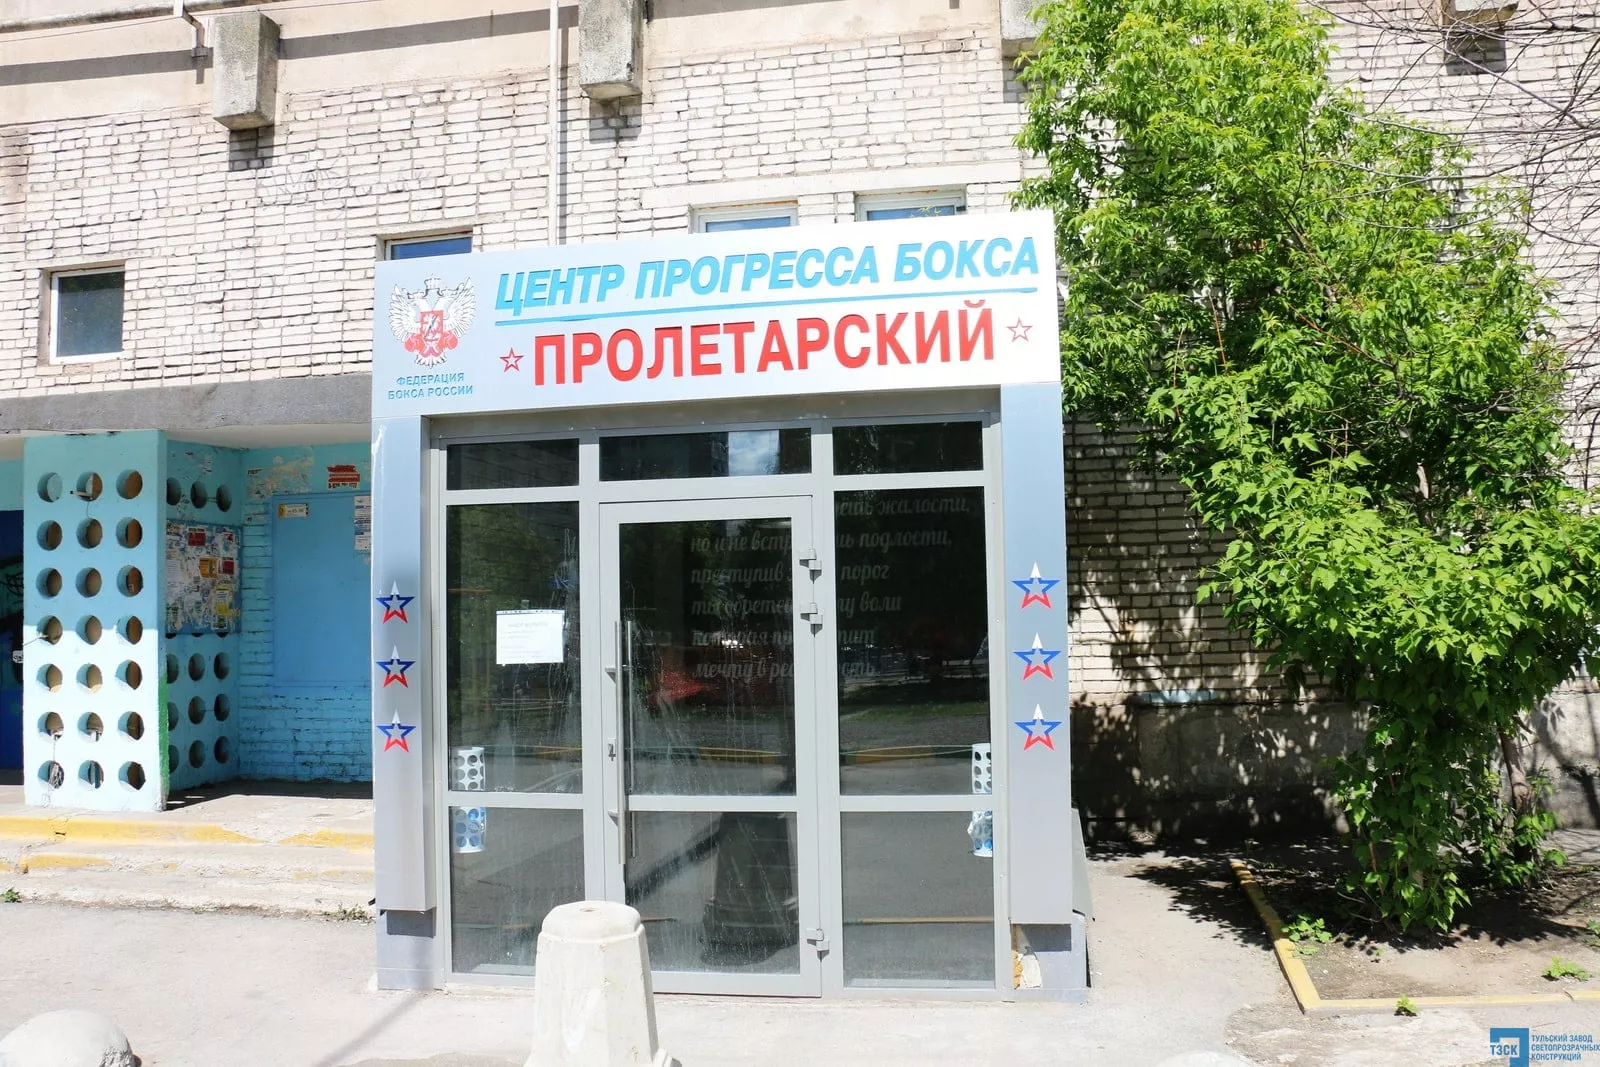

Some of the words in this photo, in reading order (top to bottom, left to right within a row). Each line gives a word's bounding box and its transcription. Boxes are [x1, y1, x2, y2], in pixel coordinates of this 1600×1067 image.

[495, 264, 625, 316] ЦЕНТР
[635, 245, 880, 299] ПРОГРЕССА
[894, 236, 1039, 282] БОКСА
[534, 299, 994, 386] ПРОЛЕТАРСКИЙ
[396, 372, 464, 386] ФЕДЕРАЦИЯ
[388, 388, 424, 400] БОКСА
[427, 385, 473, 397] РОССИИ
[840, 564, 892, 587] порог
[859, 590, 903, 612] воли
